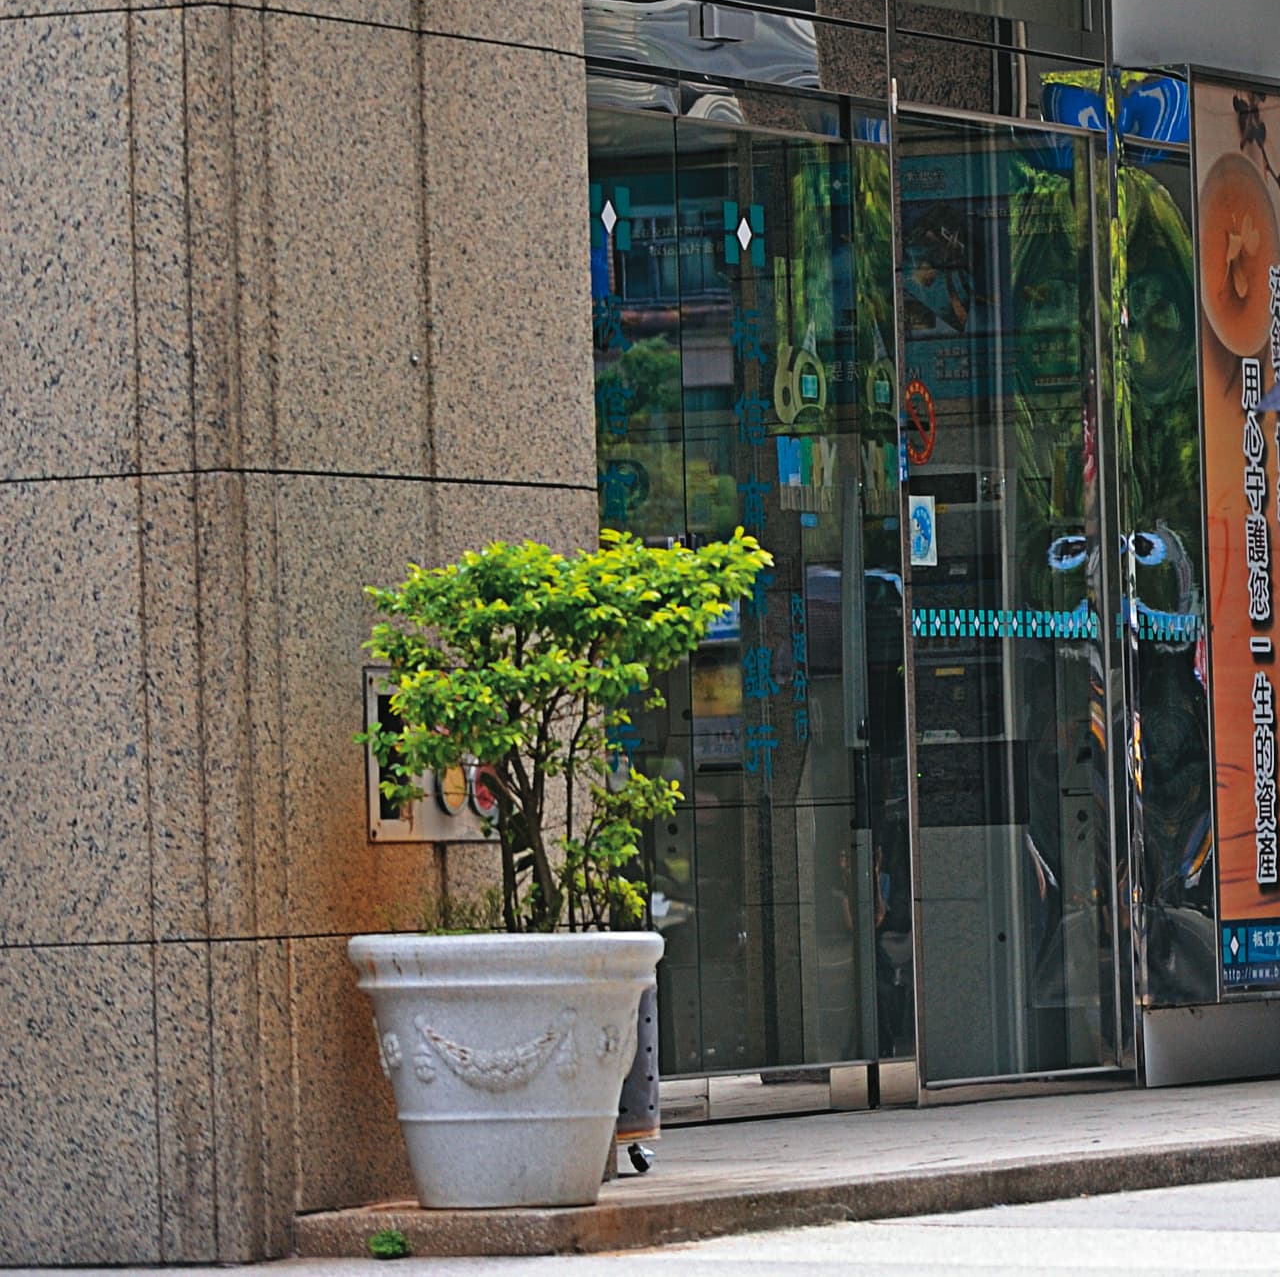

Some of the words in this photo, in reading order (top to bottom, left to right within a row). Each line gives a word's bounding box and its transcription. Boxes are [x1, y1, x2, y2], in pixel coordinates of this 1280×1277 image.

[1242, 358, 1278, 884] 用心守護您一生的資產
